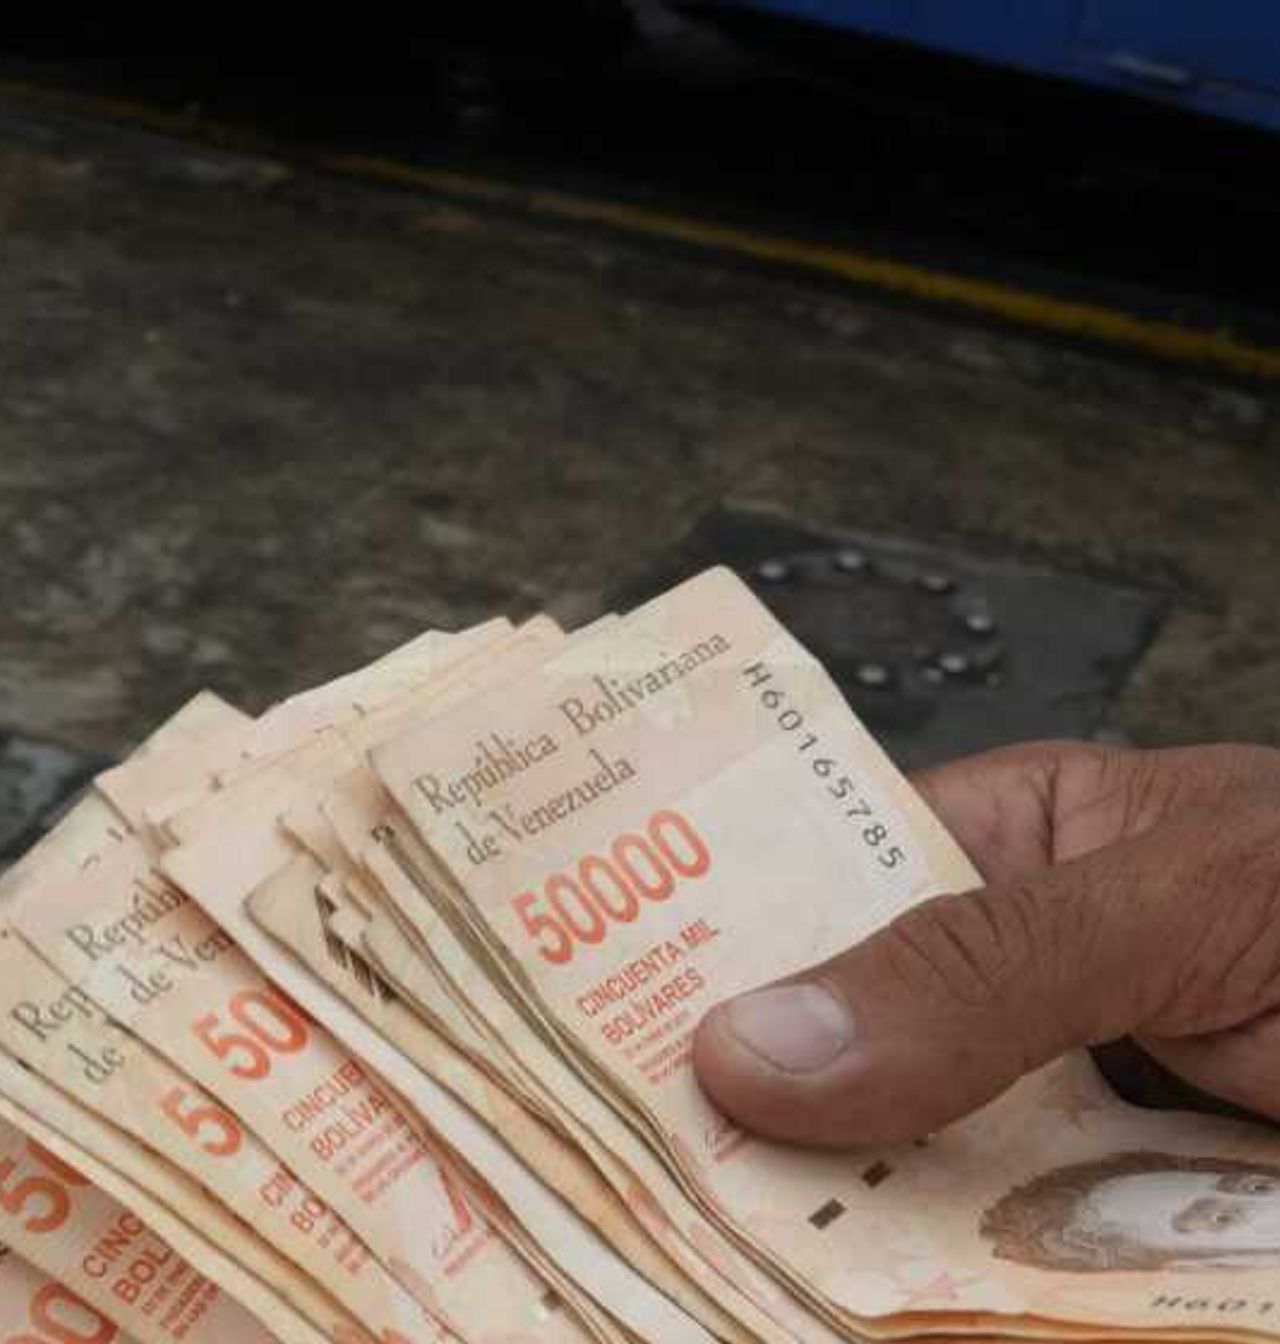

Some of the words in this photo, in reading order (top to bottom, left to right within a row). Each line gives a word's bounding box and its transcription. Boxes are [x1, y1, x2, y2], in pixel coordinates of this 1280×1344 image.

[412, 731, 559, 814] República
[557, 632, 732, 736] Bolivariana
[741, 661, 907, 868] H60165785
[455, 821, 503, 866] de
[489, 748, 637, 842] Venezuela
[511, 808, 713, 965] 50000
[118, 962, 173, 1006] de
[577, 942, 682, 1016] CINCUENTA
[67, 1043, 126, 1085] de
[191, 987, 309, 1079] 50
